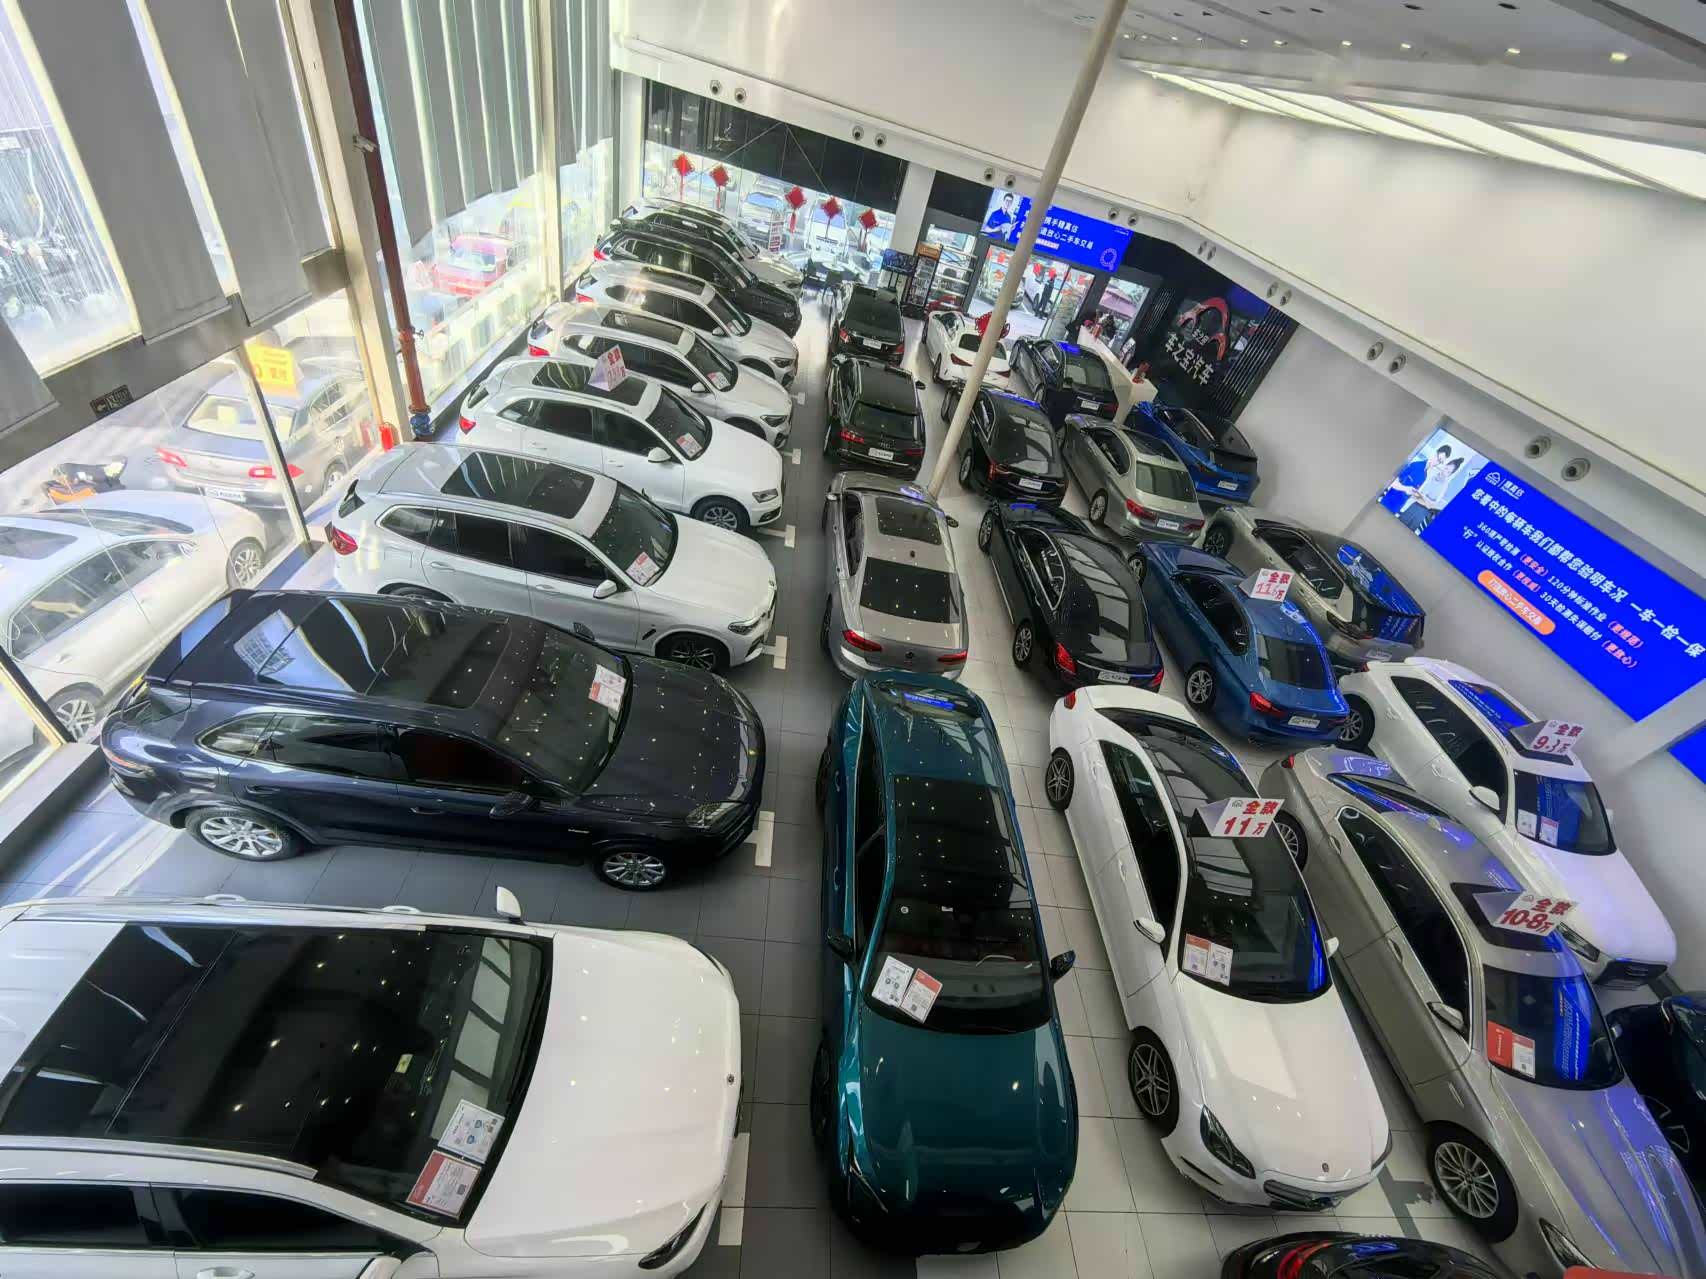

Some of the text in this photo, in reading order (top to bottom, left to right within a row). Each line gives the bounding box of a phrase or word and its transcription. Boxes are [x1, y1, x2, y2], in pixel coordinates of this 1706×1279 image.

[1242, 800, 1279, 815] 全款
[1223, 816, 1268, 836] 11万
[1531, 898, 1573, 916] 全款
